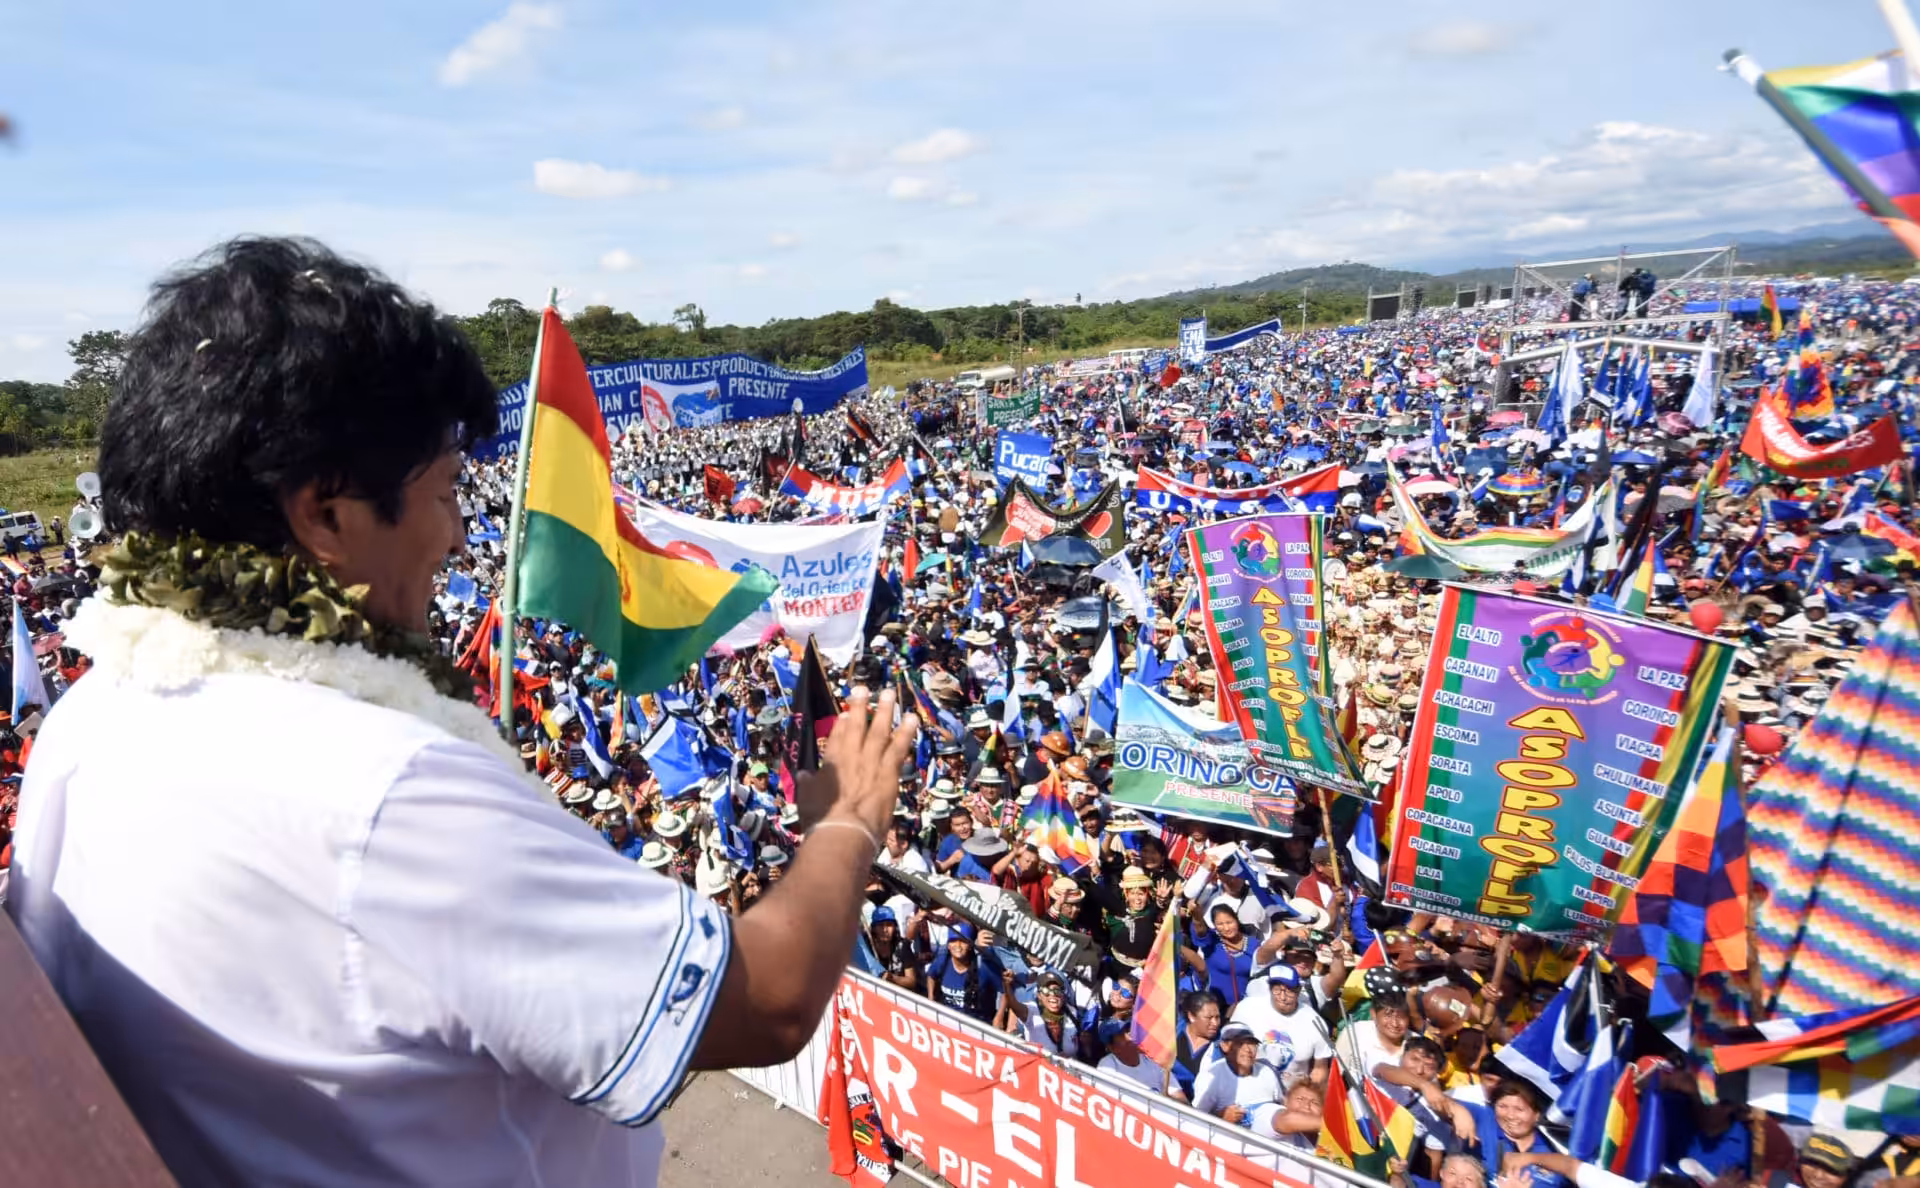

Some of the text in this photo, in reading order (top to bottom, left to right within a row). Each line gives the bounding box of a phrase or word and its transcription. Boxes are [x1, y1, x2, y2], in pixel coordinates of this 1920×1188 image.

[728, 377, 790, 399] PRESENTE
[781, 551, 872, 578] Azules
[1459, 625, 1499, 645] EL ALTO
[1446, 658, 1497, 681] CARANAVI
[1640, 666, 1686, 689] LA PAZ
[1434, 691, 1492, 714] ACHACACHI
[1625, 701, 1678, 726] COROICO
[1436, 725, 1477, 744] ESCOMA
[1618, 735, 1661, 760] VIACHA
[1120, 741, 1297, 796] ORINOCA
[1431, 756, 1470, 774] SORATA
[1429, 785, 1460, 802] APOLO
[1596, 765, 1665, 797] CHULUMANI
[1164, 780, 1254, 809] PRESENTE
[1407, 809, 1473, 835] COPACABANA
[1479, 706, 1585, 915] ASOPROFLP
[1596, 801, 1641, 827] ASUNTA
[1410, 837, 1459, 858] PUCARANI
[1588, 829, 1632, 856] GUANAY
[1566, 847, 1591, 872] PALOS
[1417, 866, 1442, 880] LAJA
[1392, 883, 1460, 906] DESAGUADERO
[1575, 886, 1615, 908] MAPIRI
[1415, 901, 1513, 927] HUMANIDAD
[890, 1010, 1020, 1089] OBRERA
[1037, 1064, 1242, 1188] REGIONAL
[938, 1145, 992, 1188] PIE
